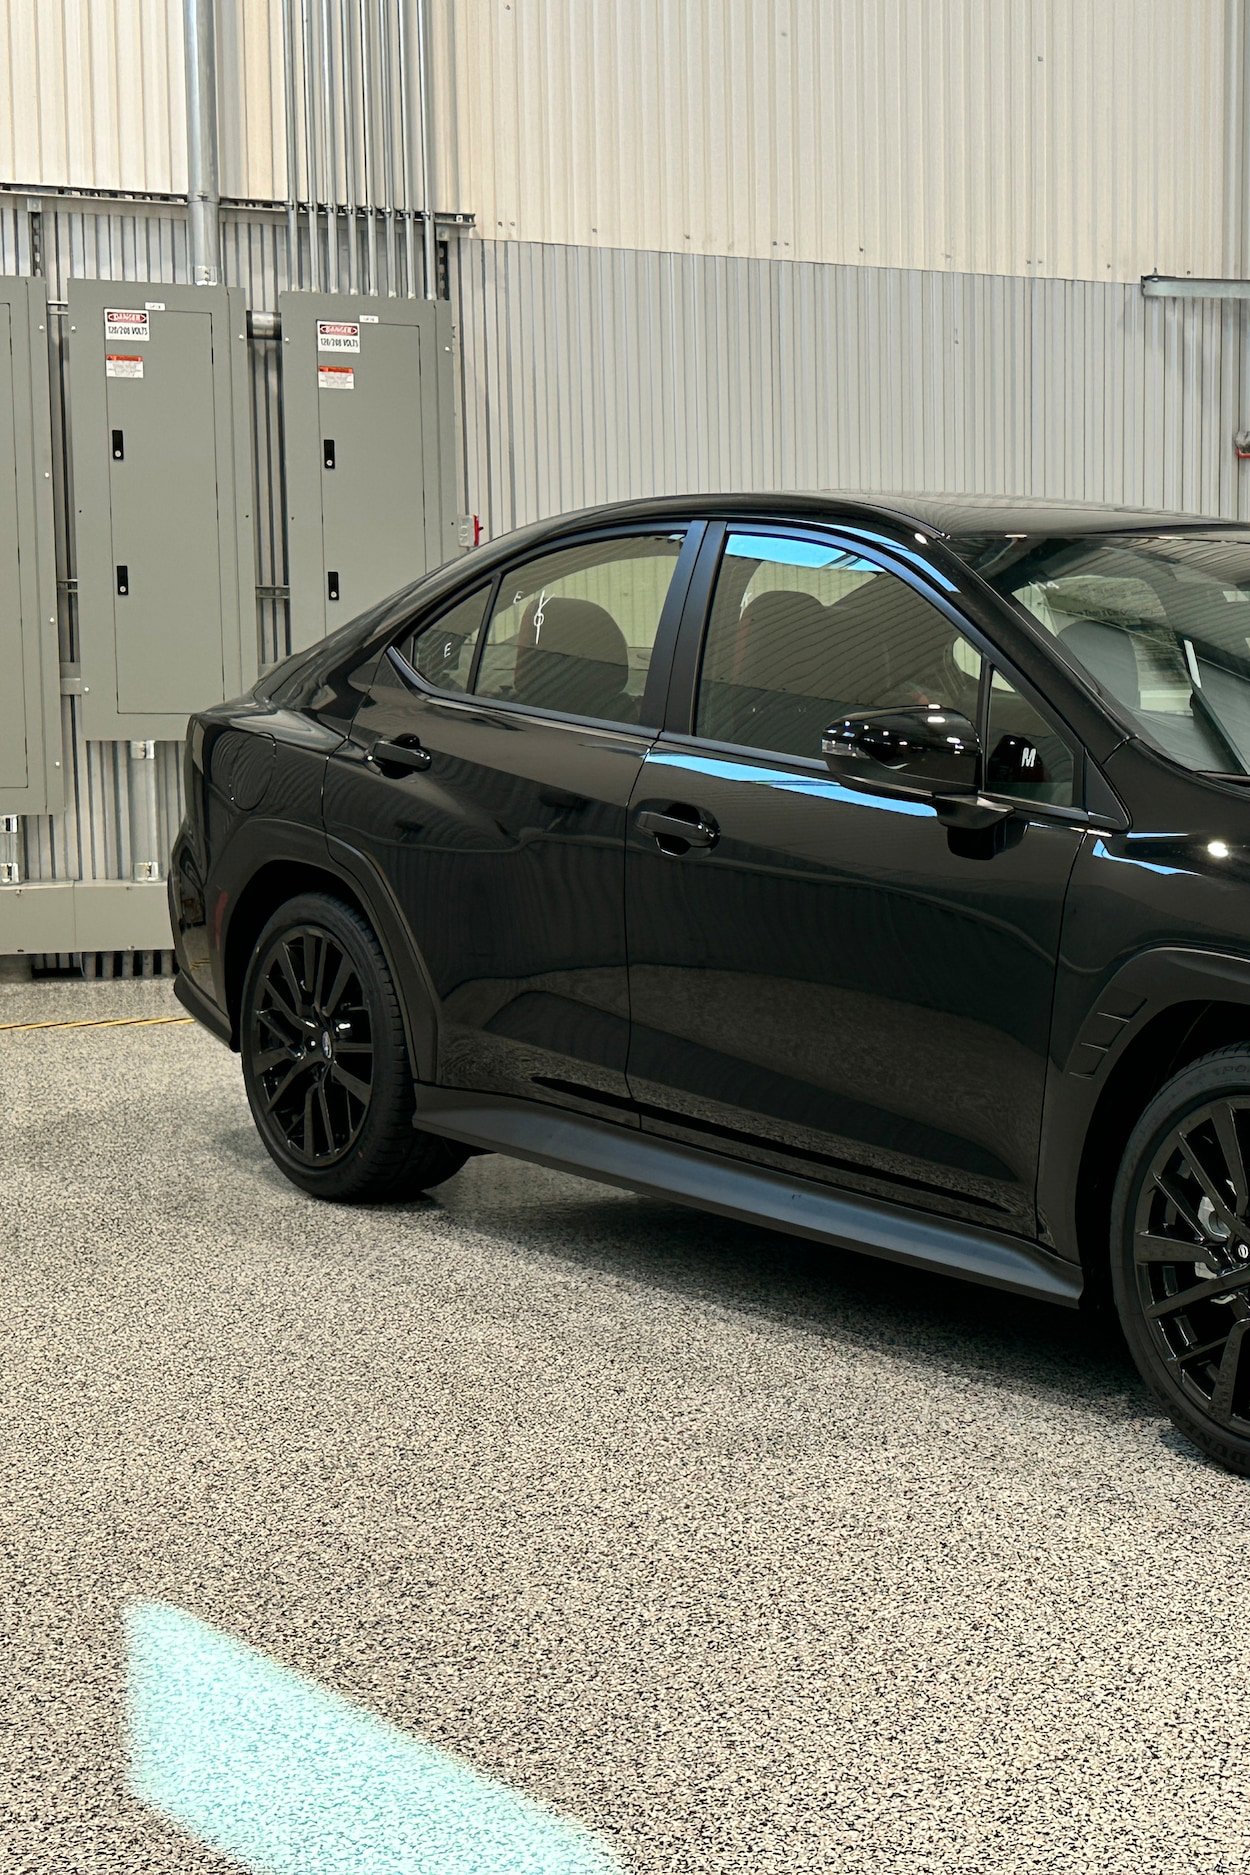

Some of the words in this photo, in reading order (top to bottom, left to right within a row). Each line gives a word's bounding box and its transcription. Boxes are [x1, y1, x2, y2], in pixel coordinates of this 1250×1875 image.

[113, 313, 141, 322] DANGER
[132, 326, 148, 336] VOLTS
[325, 325, 352, 334] DANGER
[343, 339, 359, 348] VOLTS
[1021, 747, 1037, 767] M
